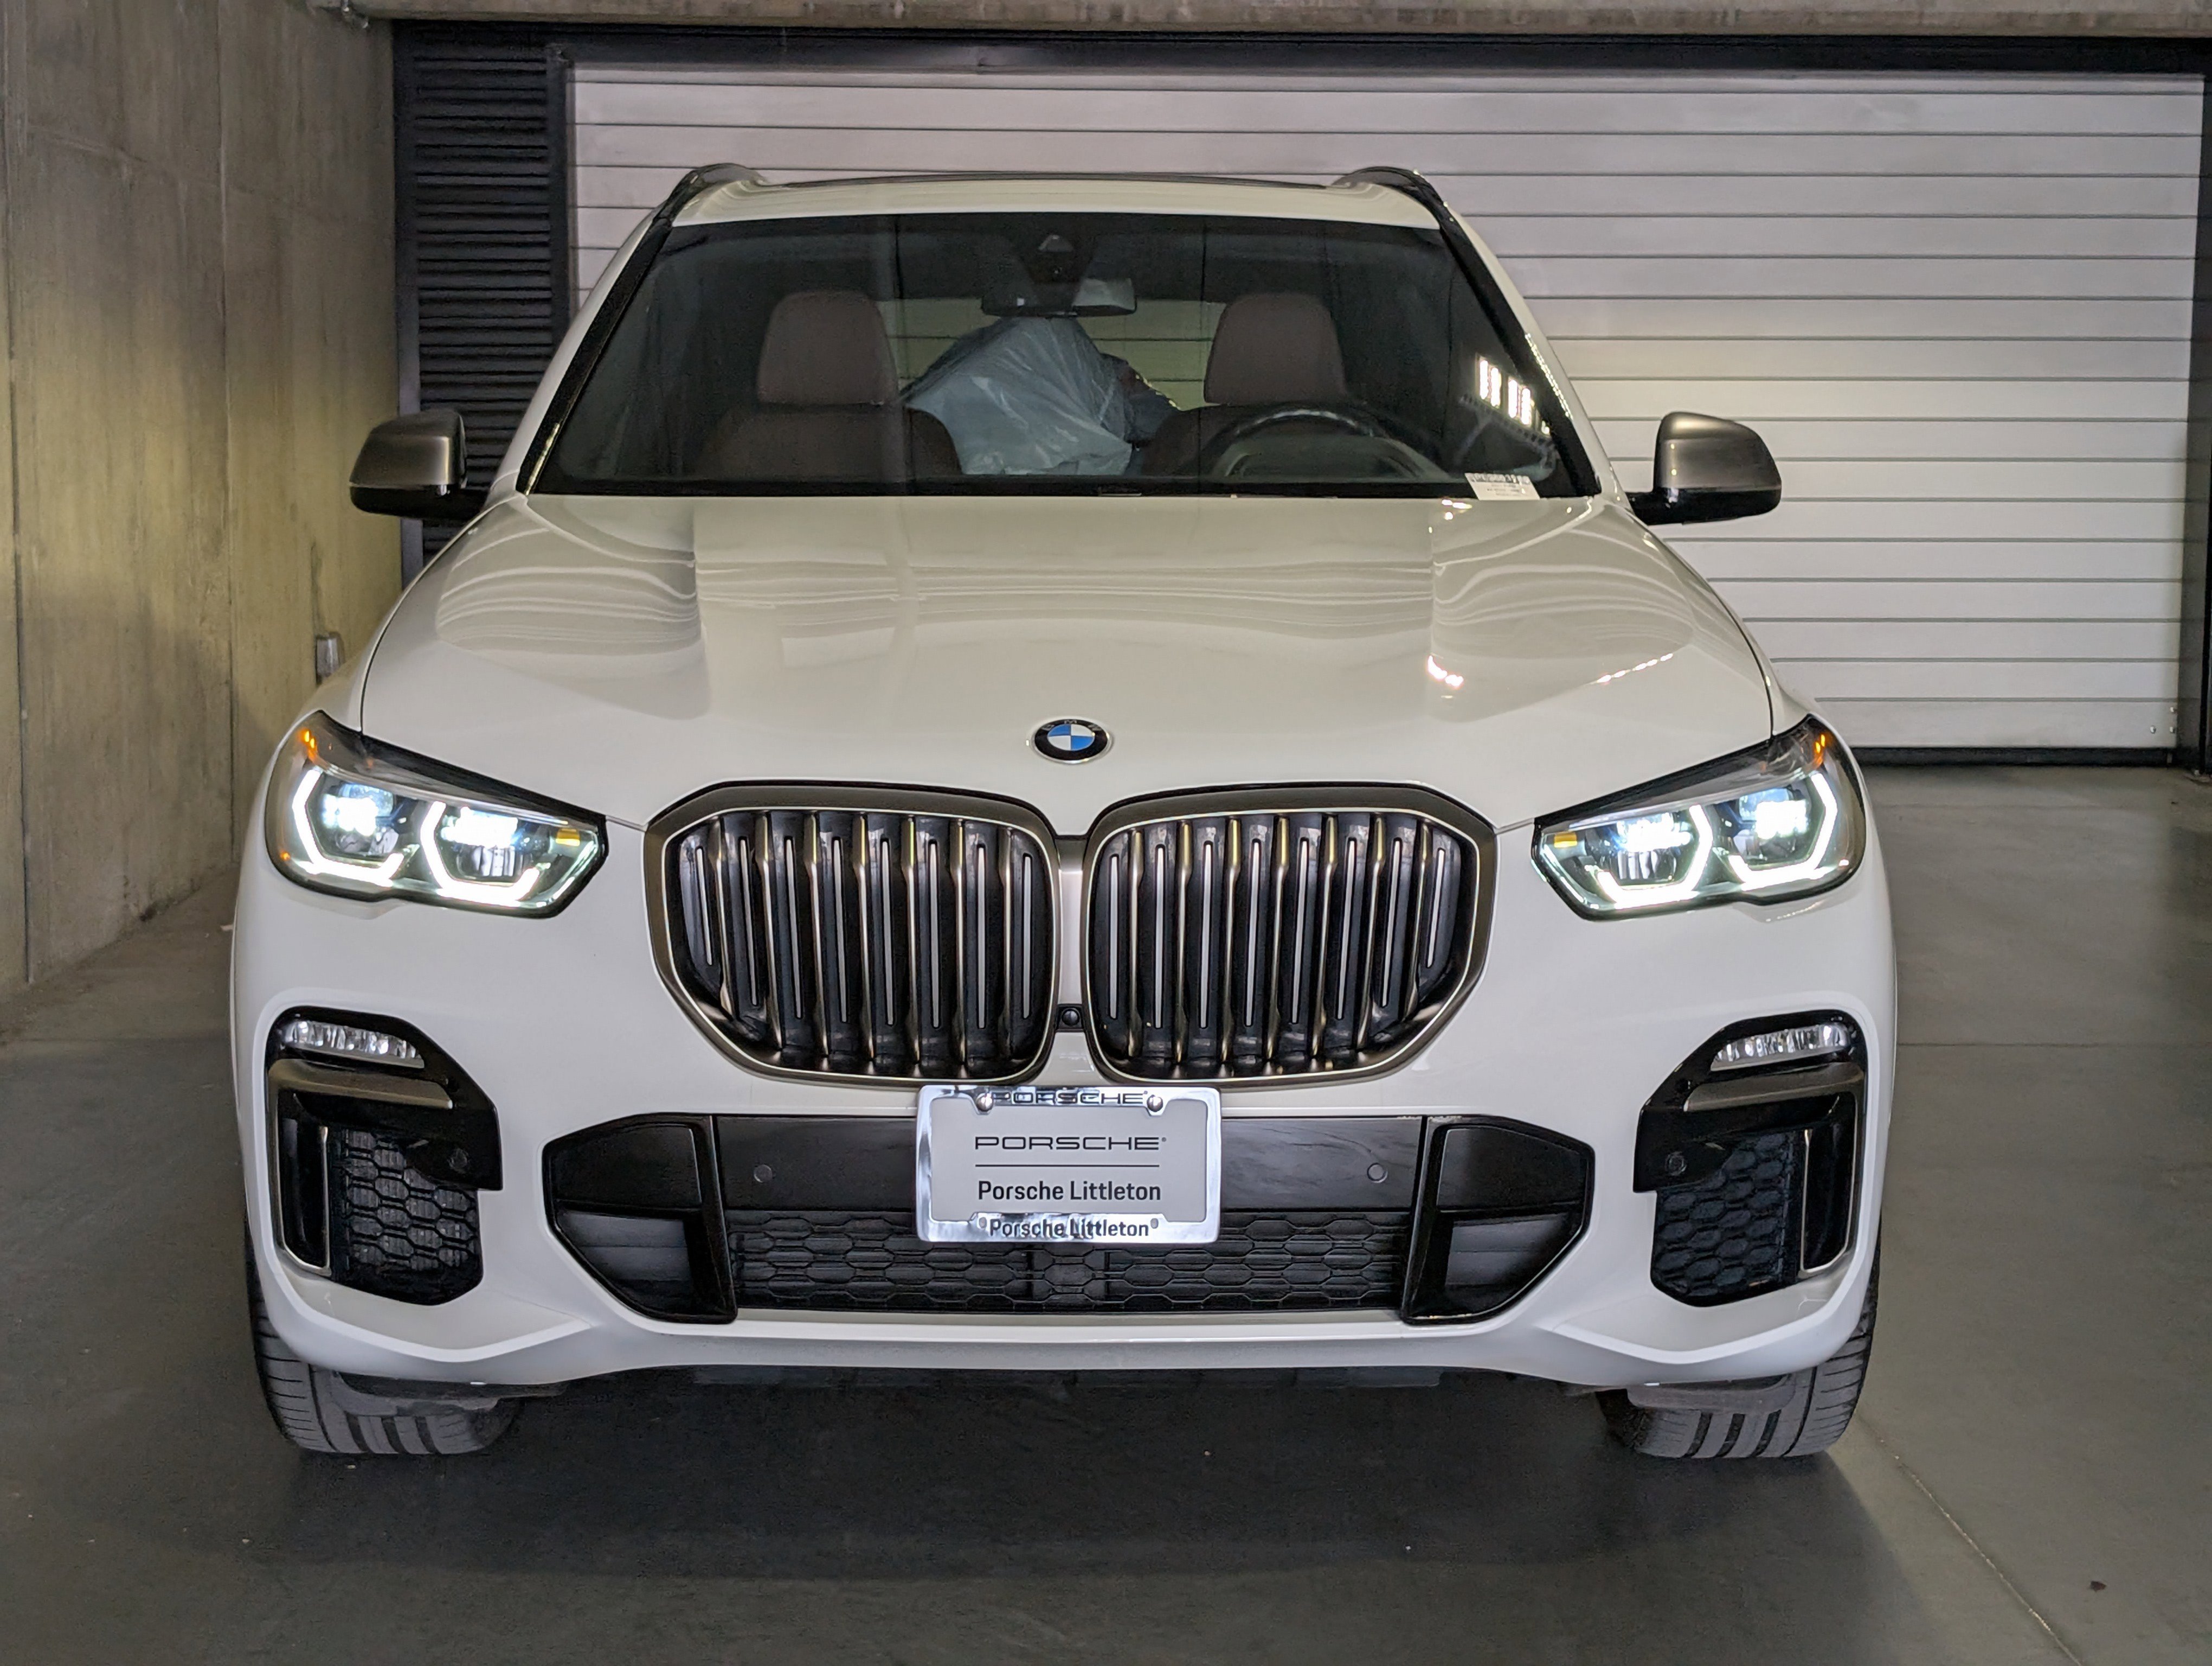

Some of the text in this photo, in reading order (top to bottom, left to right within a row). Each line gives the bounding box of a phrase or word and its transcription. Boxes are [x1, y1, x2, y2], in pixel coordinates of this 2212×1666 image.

[975, 1136, 1159, 1150] PORSCHE
[978, 1180, 1161, 1200] Porsche Littleton
[990, 1218, 1149, 1236] Porsche Littleton
